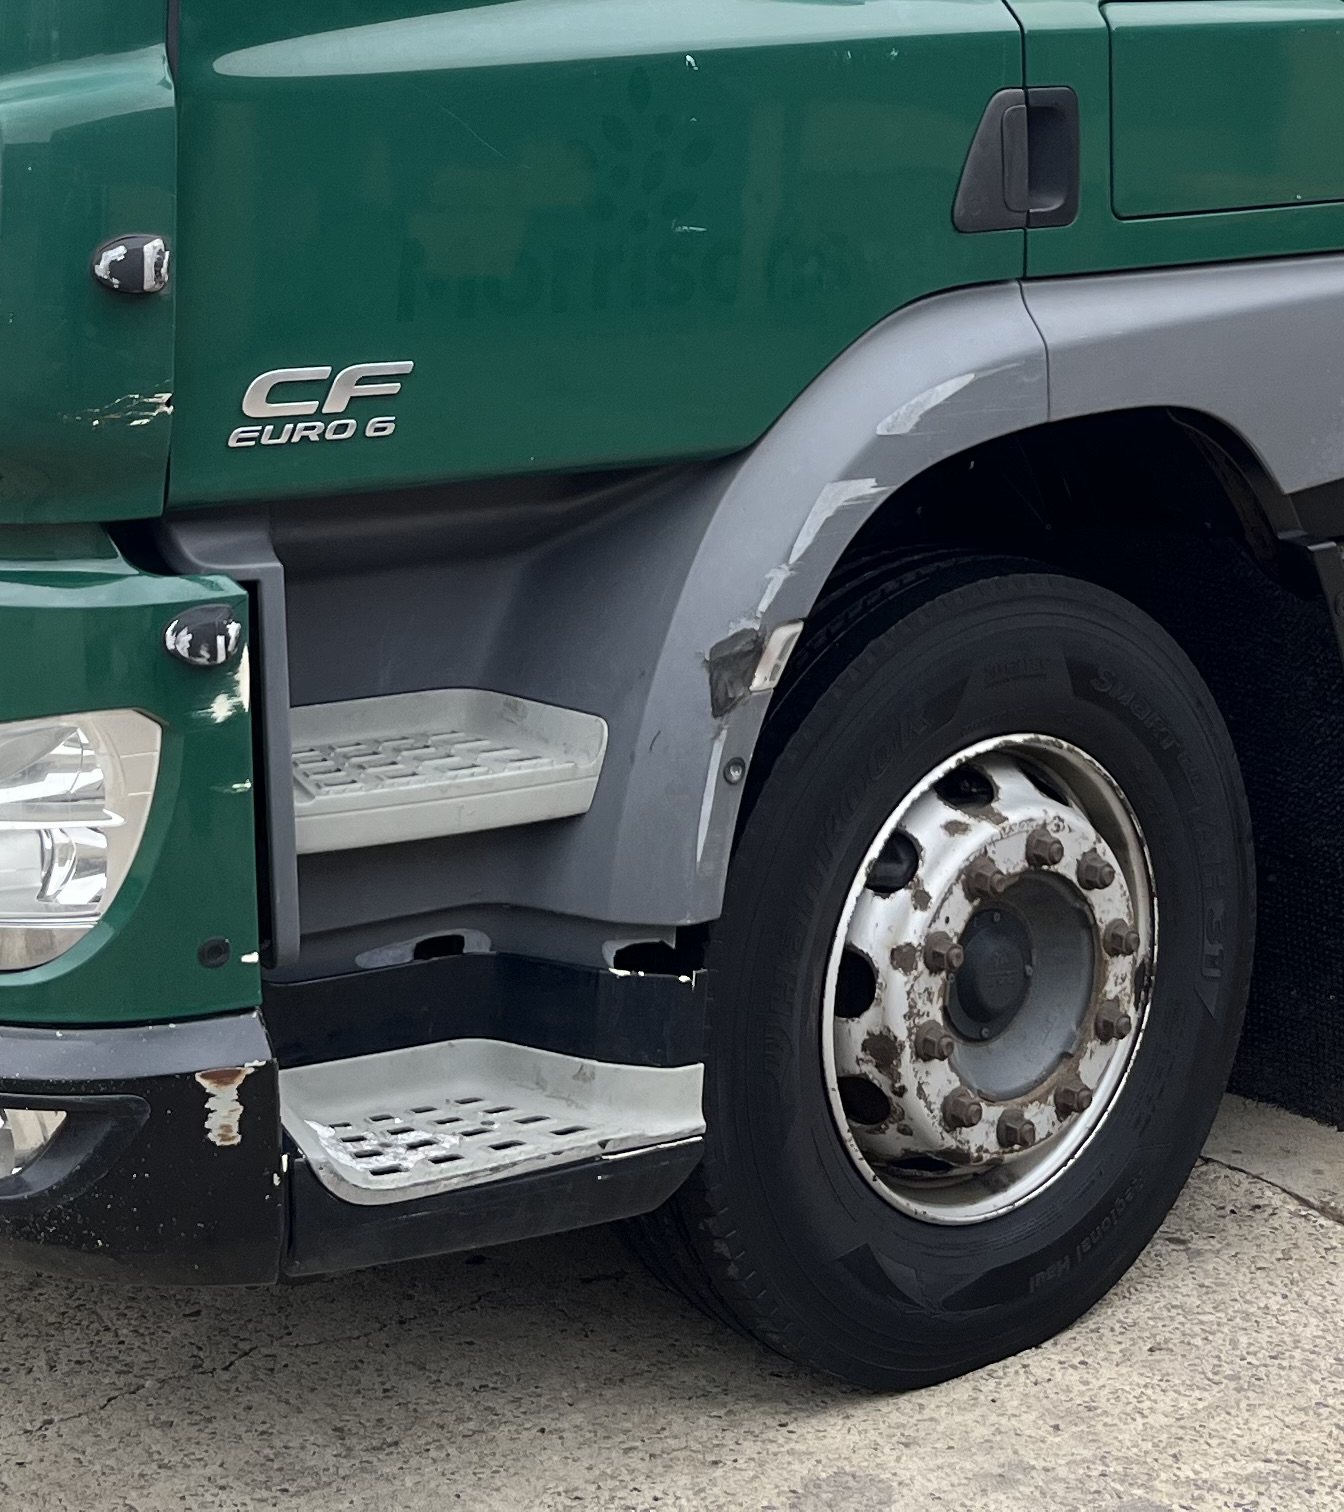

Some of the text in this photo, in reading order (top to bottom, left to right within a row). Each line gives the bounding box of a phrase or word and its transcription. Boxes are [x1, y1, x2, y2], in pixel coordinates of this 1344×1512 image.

[241, 361, 414, 417] CF
[227, 416, 397, 449] EURO 6
